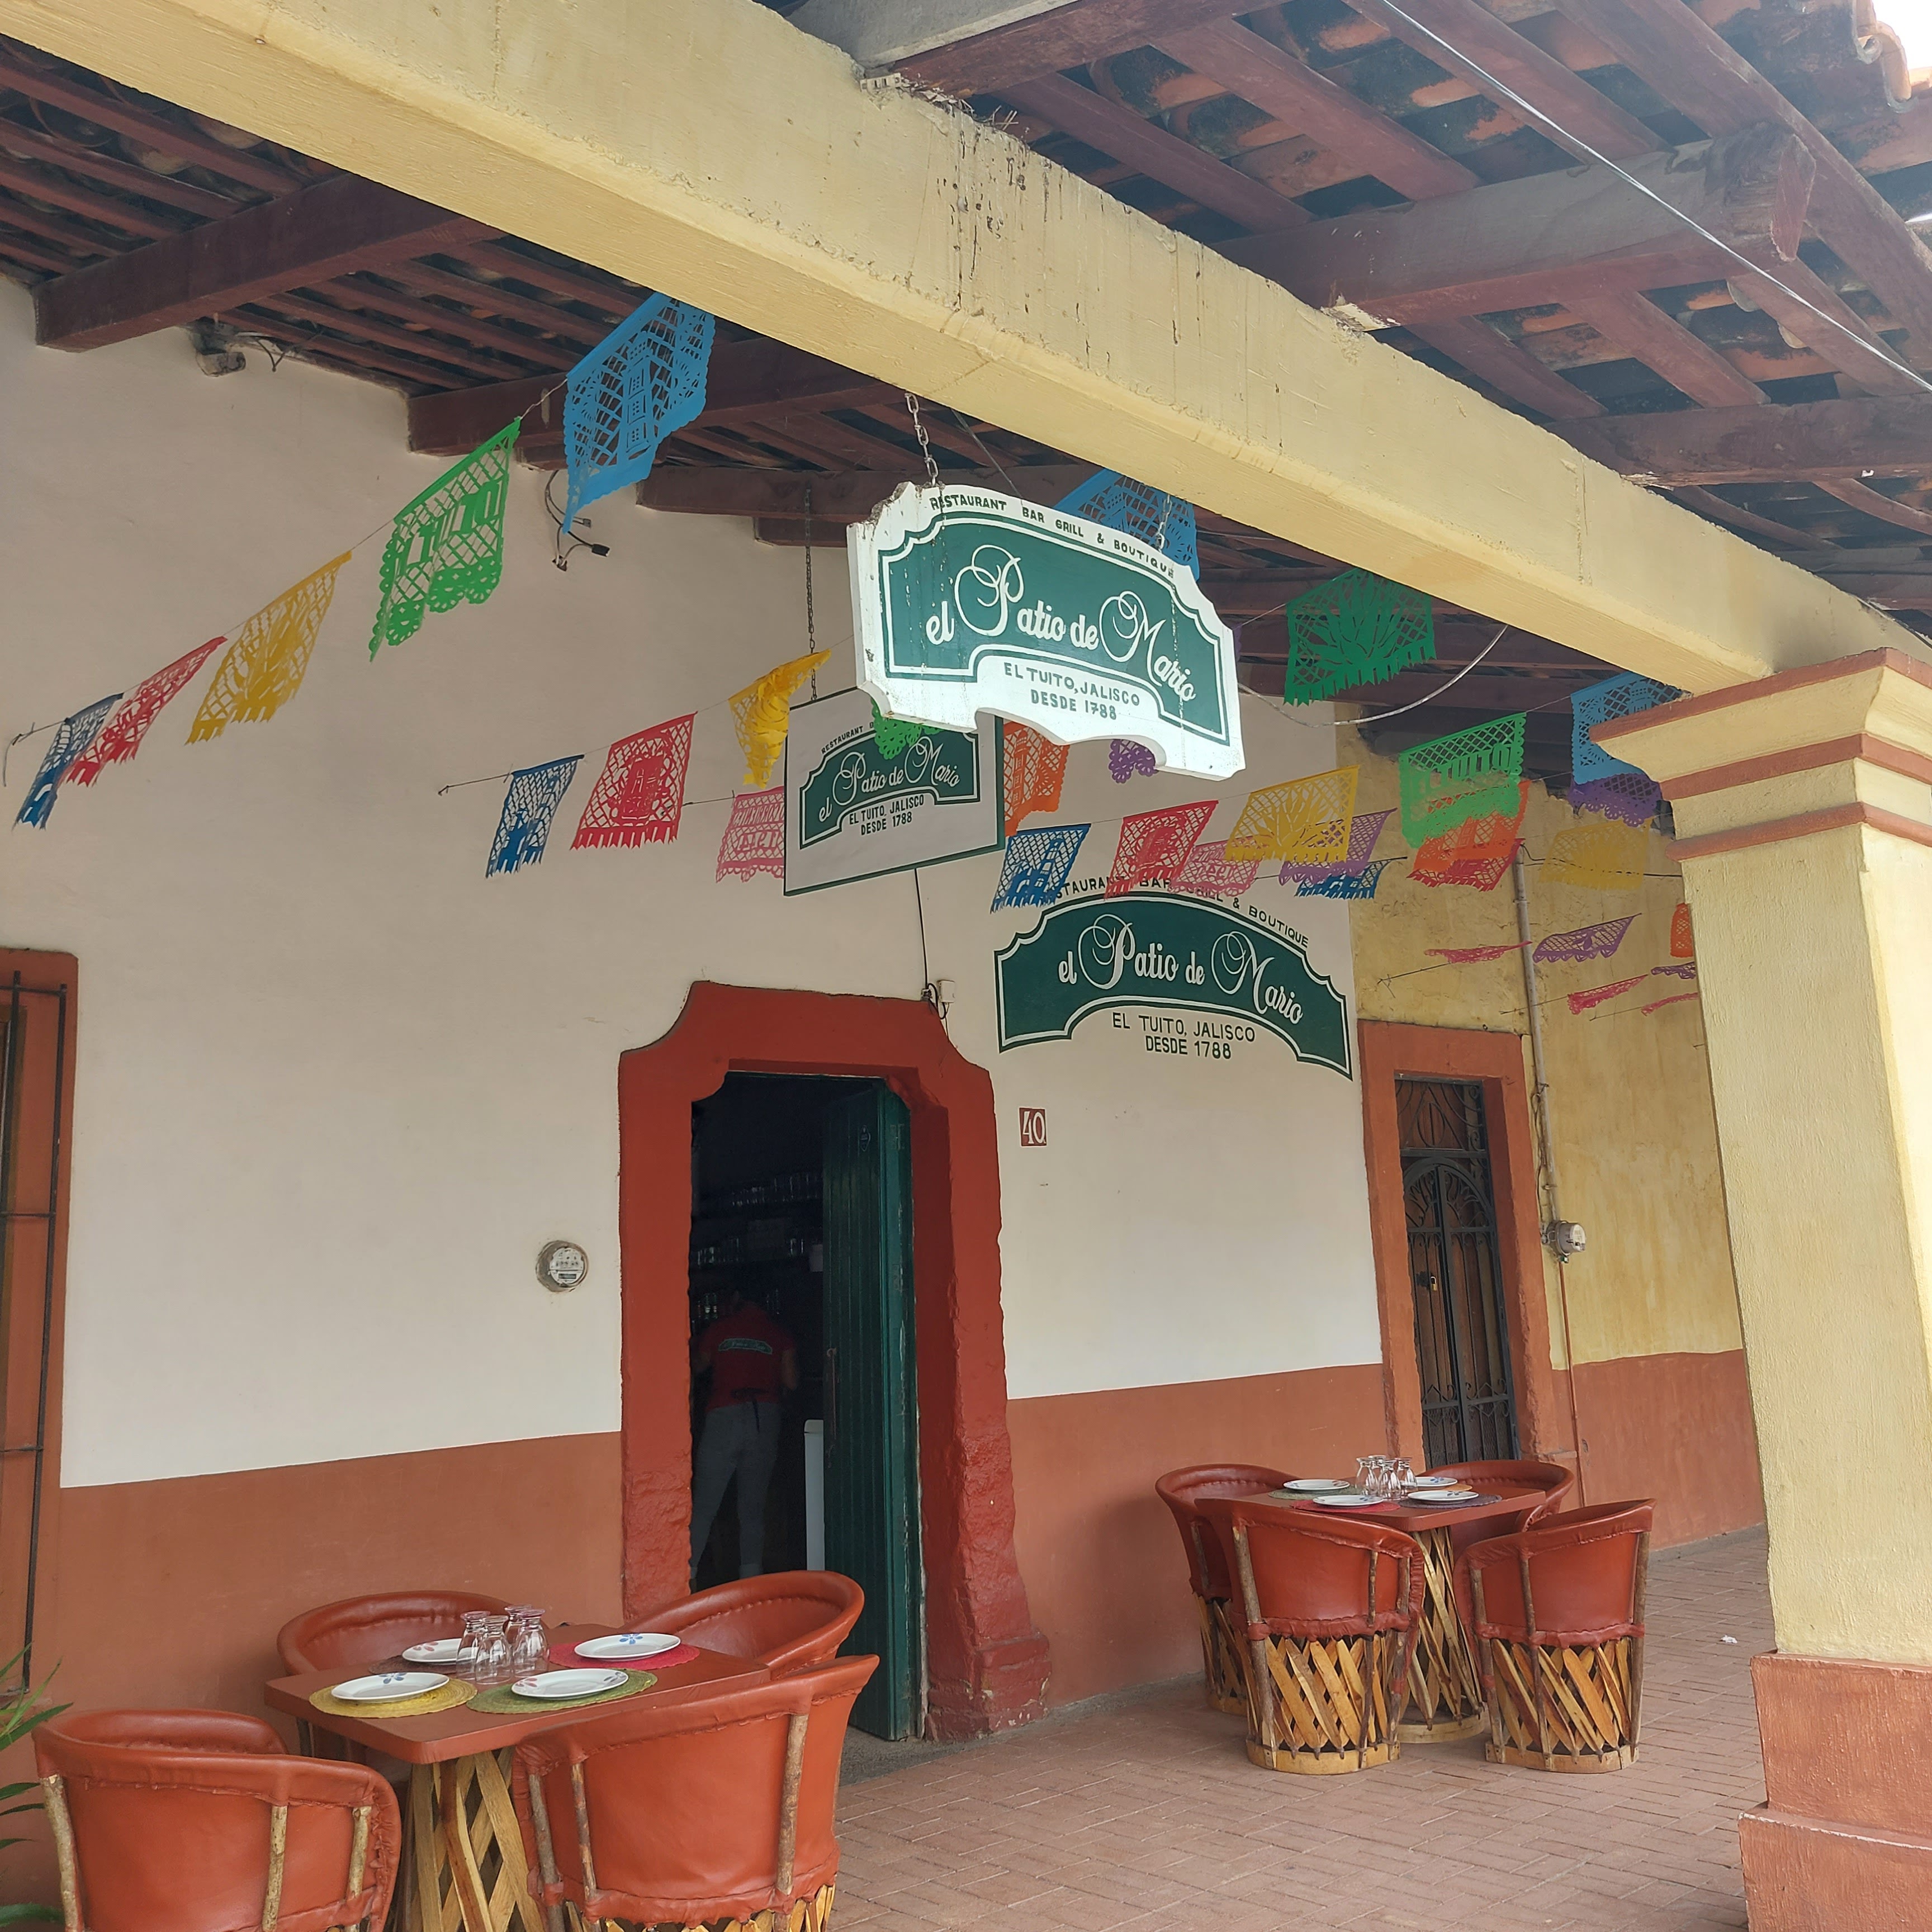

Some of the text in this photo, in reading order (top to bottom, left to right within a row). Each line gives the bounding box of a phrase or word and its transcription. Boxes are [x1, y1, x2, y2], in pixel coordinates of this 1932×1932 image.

[929, 495, 1175, 578] RESTAURANT BAR GRILL & BOUTIQUE
[926, 544, 1196, 702] el Patio de Mario
[1004, 662, 1139, 705] EL TUITO, JALISCO
[1031, 689, 1116, 720] DESDE 1788
[821, 726, 863, 754] RESTAURANT
[819, 797, 832, 822] el
[832, 751, 887, 806] Patio
[889, 766, 904, 790] de
[905, 736, 959, 787] Mario
[849, 813, 859, 825] EL
[889, 794, 924, 814] JALISCO
[861, 812, 912, 836] DESDE 1788
[1233, 897, 1239, 910] &
[1248, 906, 1309, 948] BOUTIQUE
[1058, 914, 1303, 1024] el Patio de Mario
[1112, 1013, 1130, 1030] EL
[1193, 1021, 1255, 1043] JALISCO
[1145, 1035, 1231, 1059] DESDE 1788
[1023, 1111, 1045, 1144] 40
